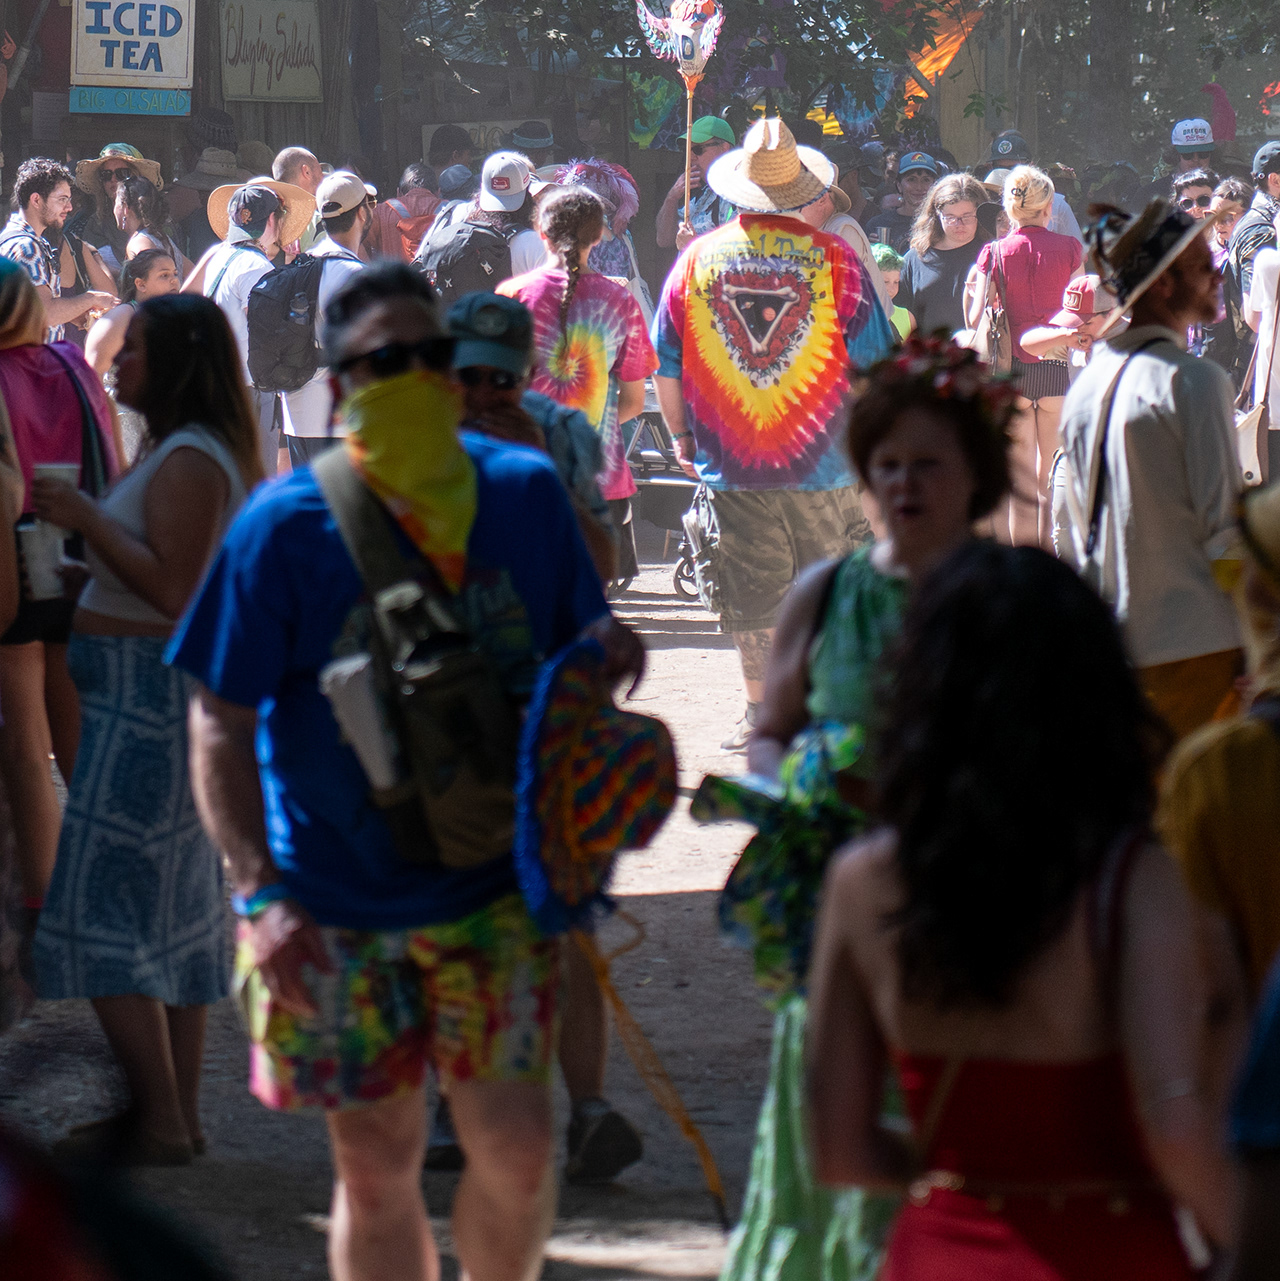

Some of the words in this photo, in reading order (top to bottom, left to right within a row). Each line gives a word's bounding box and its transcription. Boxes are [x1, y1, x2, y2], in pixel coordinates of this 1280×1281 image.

[84, 1, 184, 38] ICED
[99, 39, 164, 73] TEA
[275, 11, 322, 82] Salads
[77, 88, 106, 110] BIG
